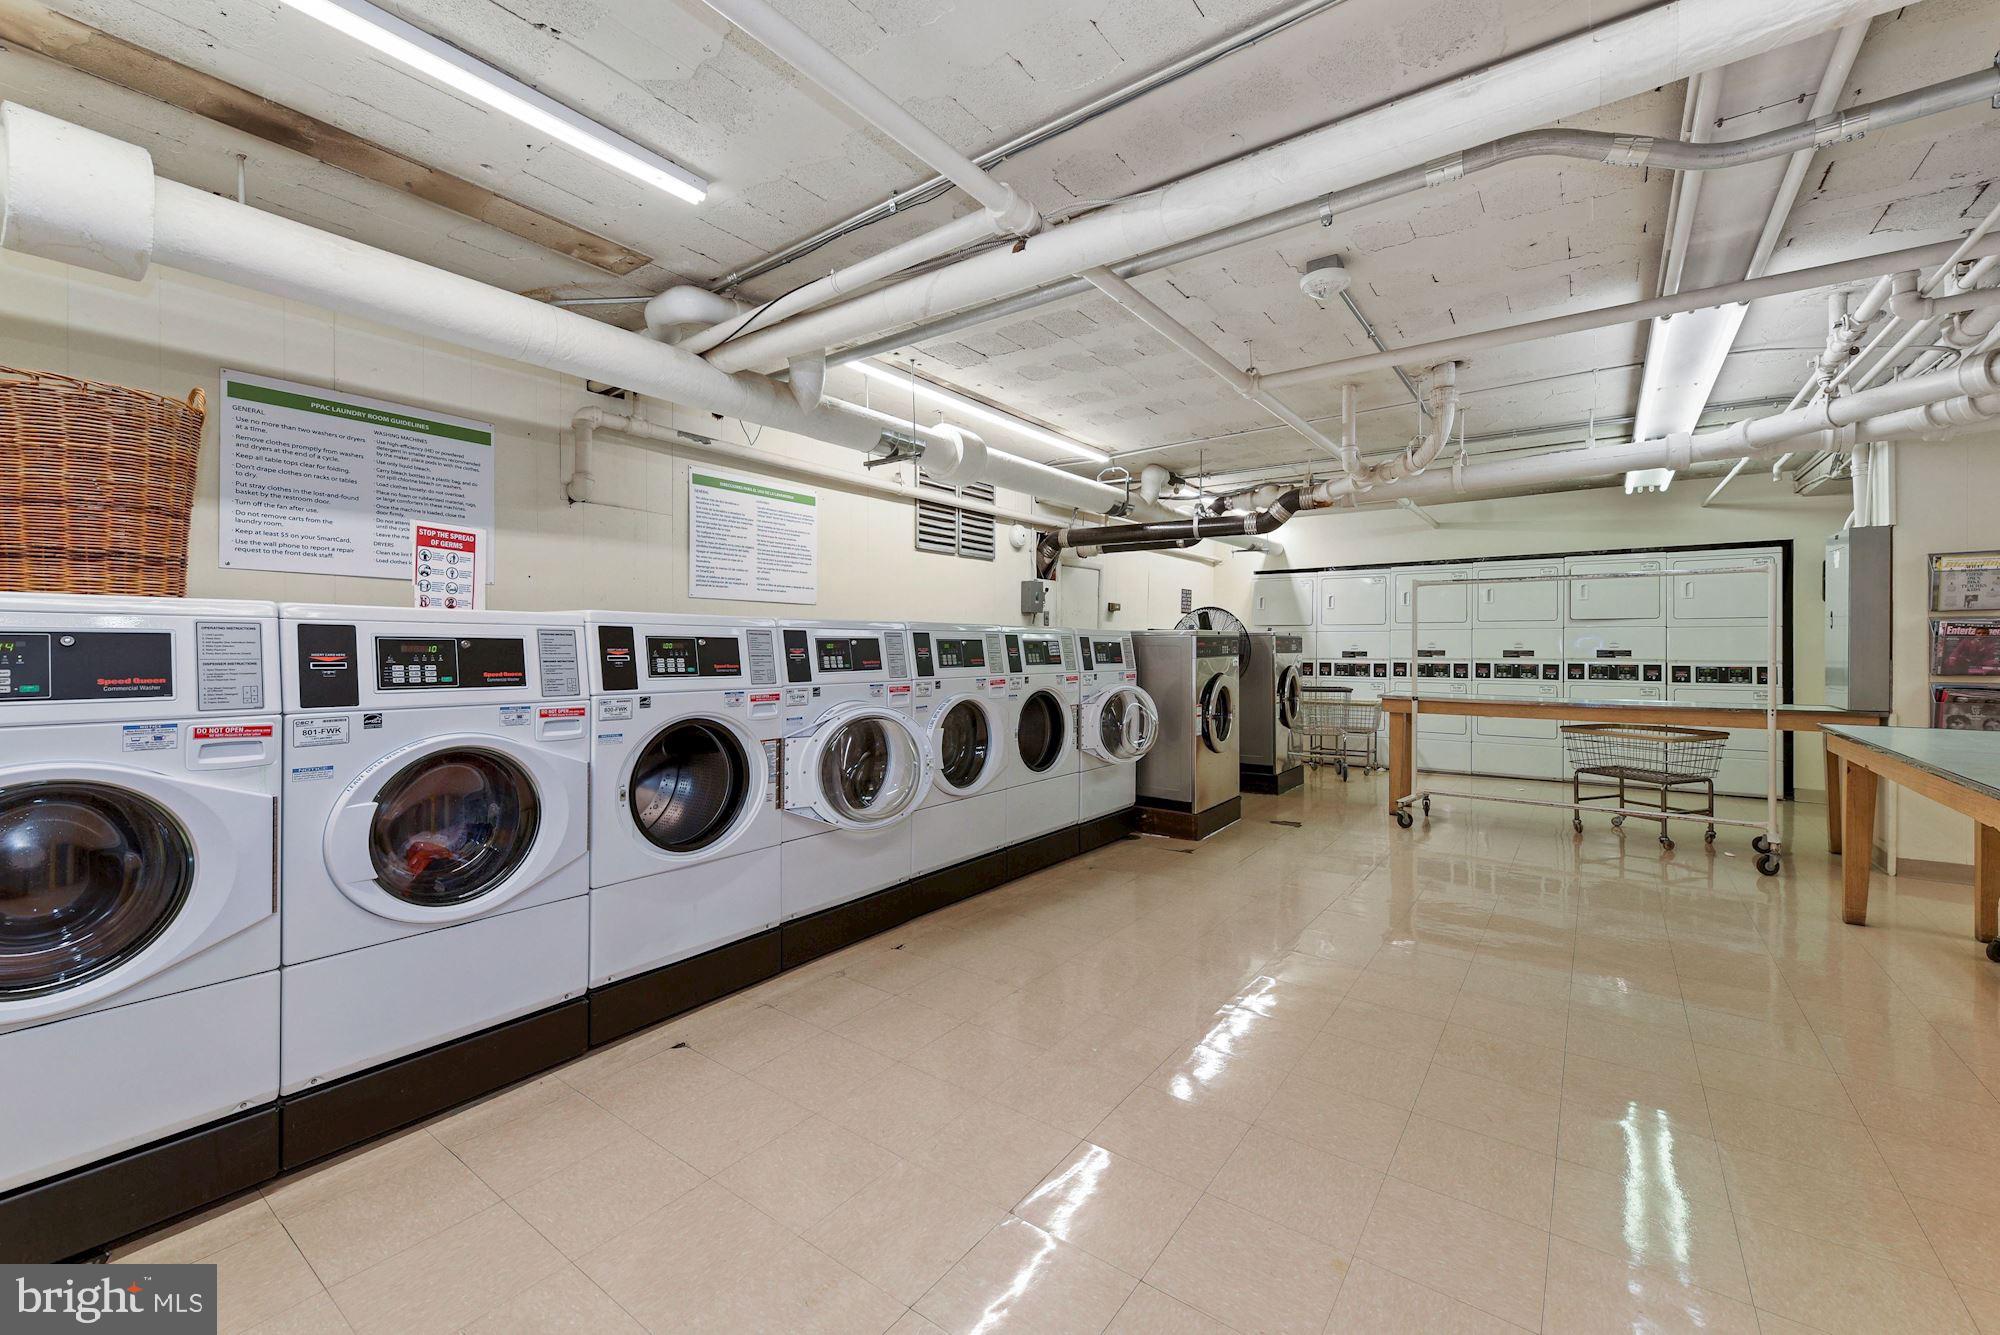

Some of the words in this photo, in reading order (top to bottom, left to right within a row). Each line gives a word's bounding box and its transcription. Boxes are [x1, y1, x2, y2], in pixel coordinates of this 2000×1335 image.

[232, 404, 265, 416] GENERAL
[311, 402, 330, 412] PPAC
[332, 406, 365, 418] LAUNDRY
[368, 413, 389, 423] ROOM
[391, 417, 429, 430] GUIDELINES
[250, 425, 268, 434] time.
[312, 429, 338, 438] washers
[346, 435, 366, 444] dryers
[374, 430, 399, 439] WASHING
[401, 435, 428, 444] MACHINES
[235, 434, 264, 444] Remove
[265, 438, 291, 448] clothes
[292, 443, 321, 454] promptly
[339, 450, 364, 459] washers
[250, 444, 273, 454] dryers
[322, 454, 340, 463] cycle.
[235, 452, 254, 461] Keep
[284, 459, 299, 467] tops
[326, 465, 350, 475] folding.
[235, 462, 255, 470] Don't
[256, 465, 277, 474] drape
[278, 468, 302, 477] clothes
[244, 471, 258, 479] dry.
[235, 488, 259, 496] basket
[283, 494, 313, 502] restroom
[249, 483, 266, 491] stray
[267, 485, 292, 493] clothes
[313, 491, 360, 501] lost-and-found
[235, 517, 262, 526] laundry
[235, 528, 253, 536] Keep
[317, 535, 352, 543] SmartCard.
[419, 528, 436, 538] STOP
[438, 531, 449, 539] THE
[450, 533, 474, 542] SPREAD
[234, 546, 262, 554] request
[278, 542, 301, 550] phone
[302, 727, 342, 736] 801-FWK
[346, 775, 364, 792] LEAVE
[366, 759, 384, 774] OPEN
